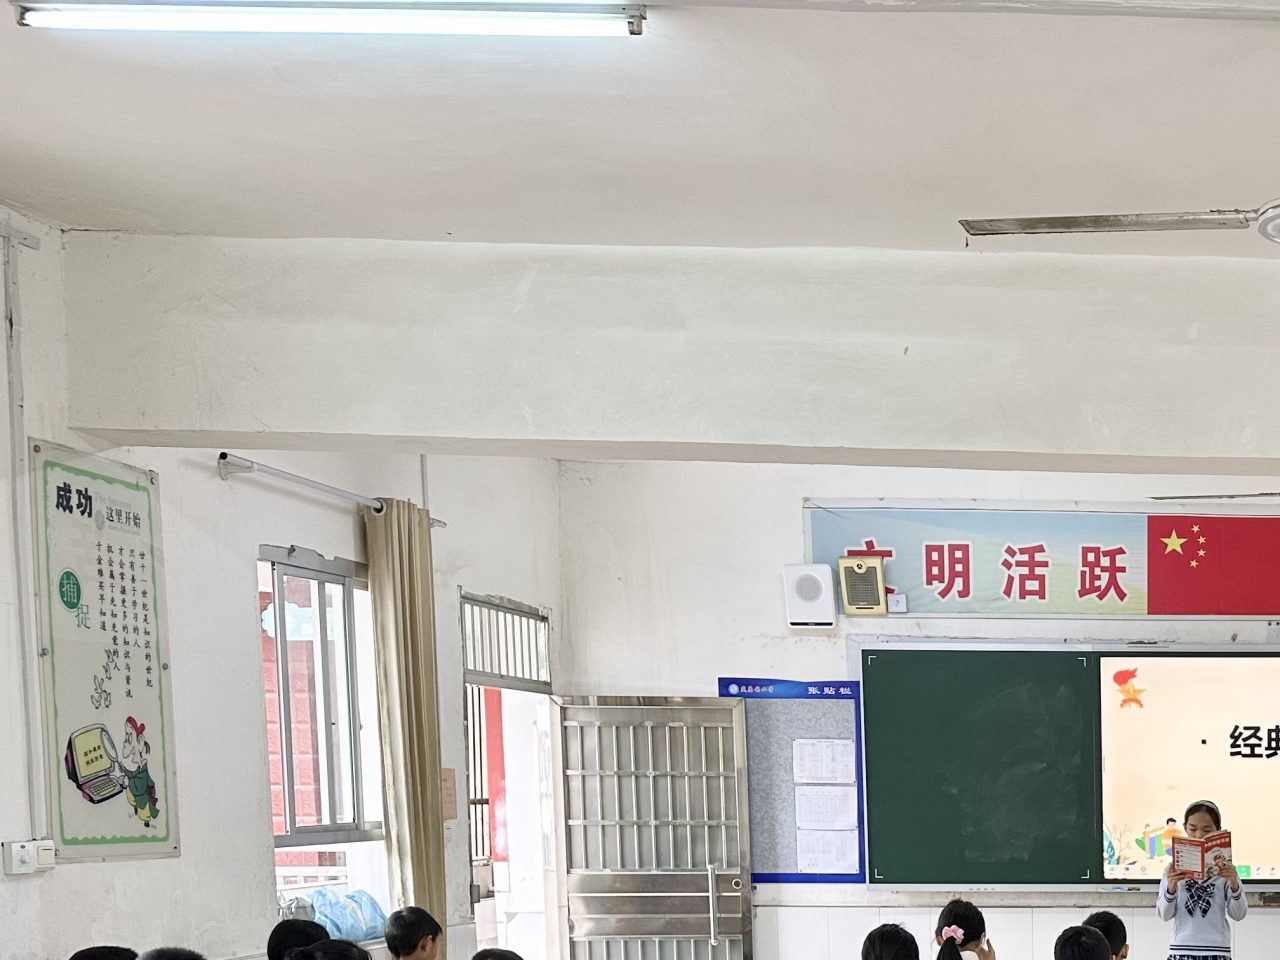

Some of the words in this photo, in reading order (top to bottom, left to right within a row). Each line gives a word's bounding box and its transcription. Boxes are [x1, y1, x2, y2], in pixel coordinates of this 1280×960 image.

[55, 481, 93, 518] 成功
[105, 506, 141, 529] 这里开始
[61, 575, 91, 630] 捕捉
[96, 541, 107, 632] 千金难买早知道
[128, 549, 141, 649] 只有善于学习的人
